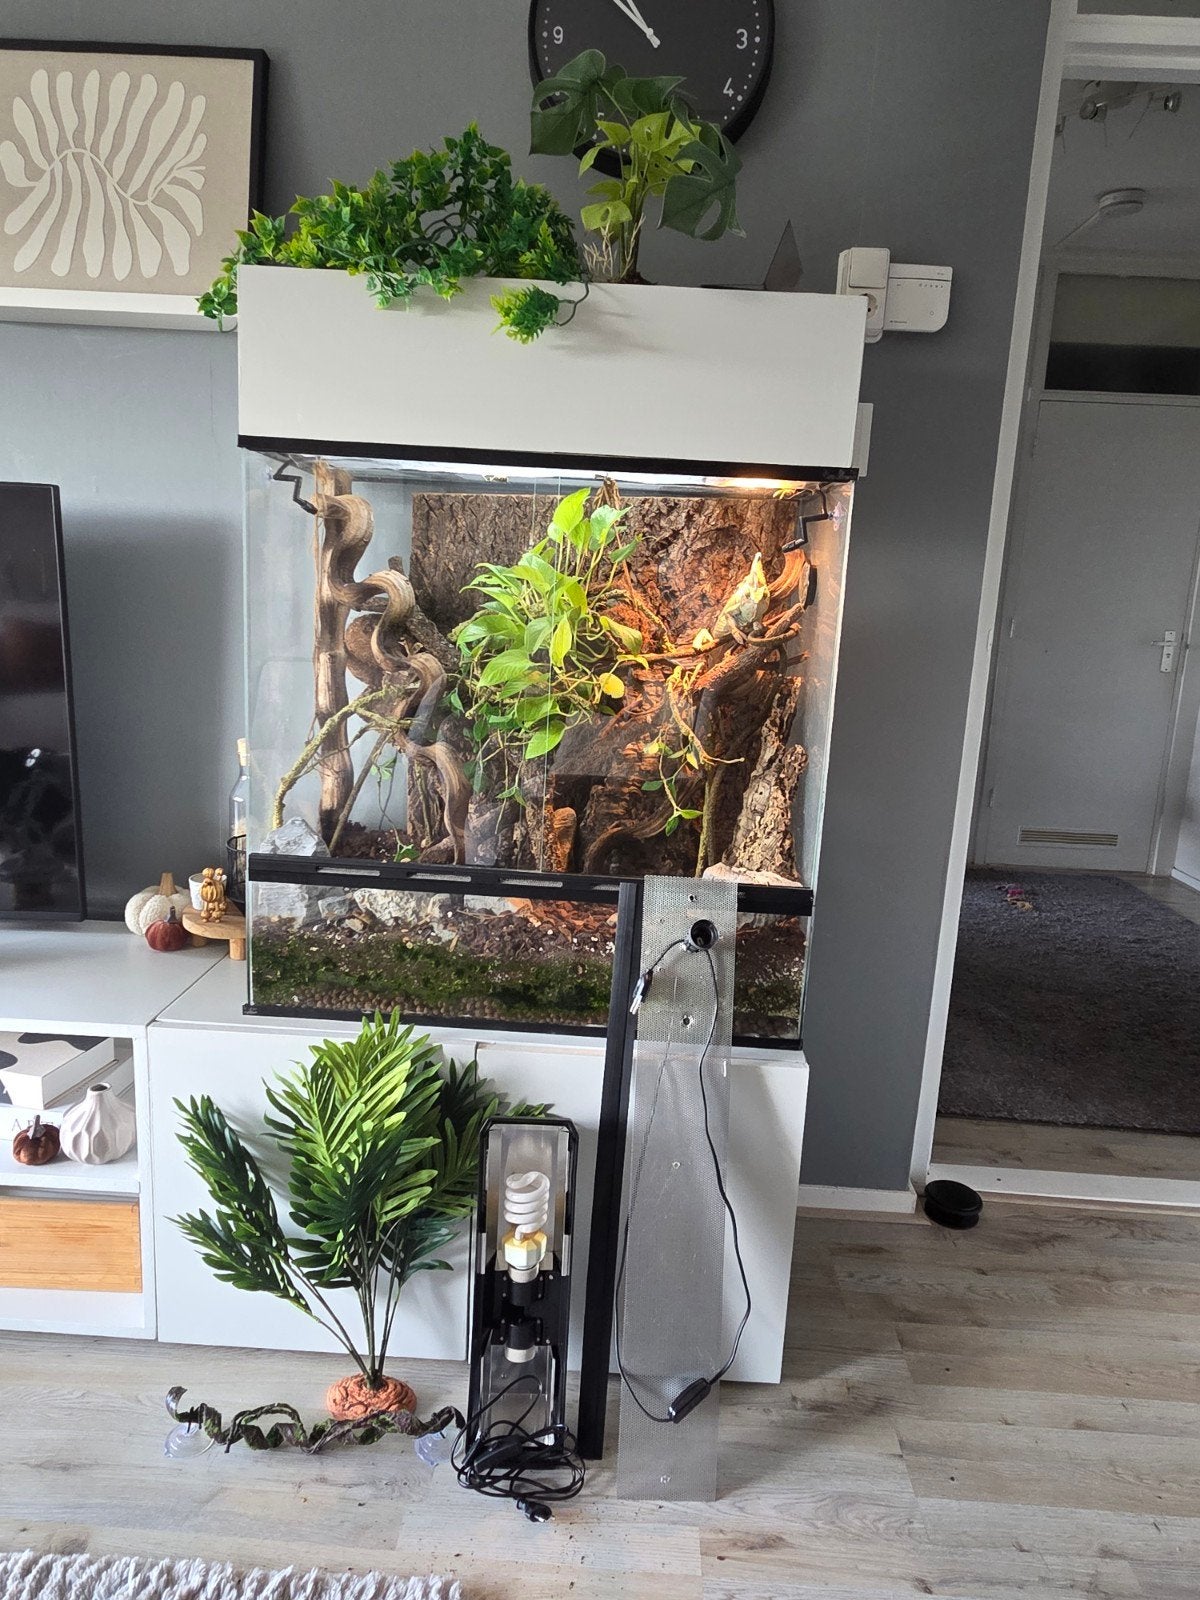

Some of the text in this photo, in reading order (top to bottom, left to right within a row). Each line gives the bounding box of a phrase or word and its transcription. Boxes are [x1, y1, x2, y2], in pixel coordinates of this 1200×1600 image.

[553, 26, 563, 44] 9
[736, 28, 748, 49] 3
[723, 77, 734, 97] 4
